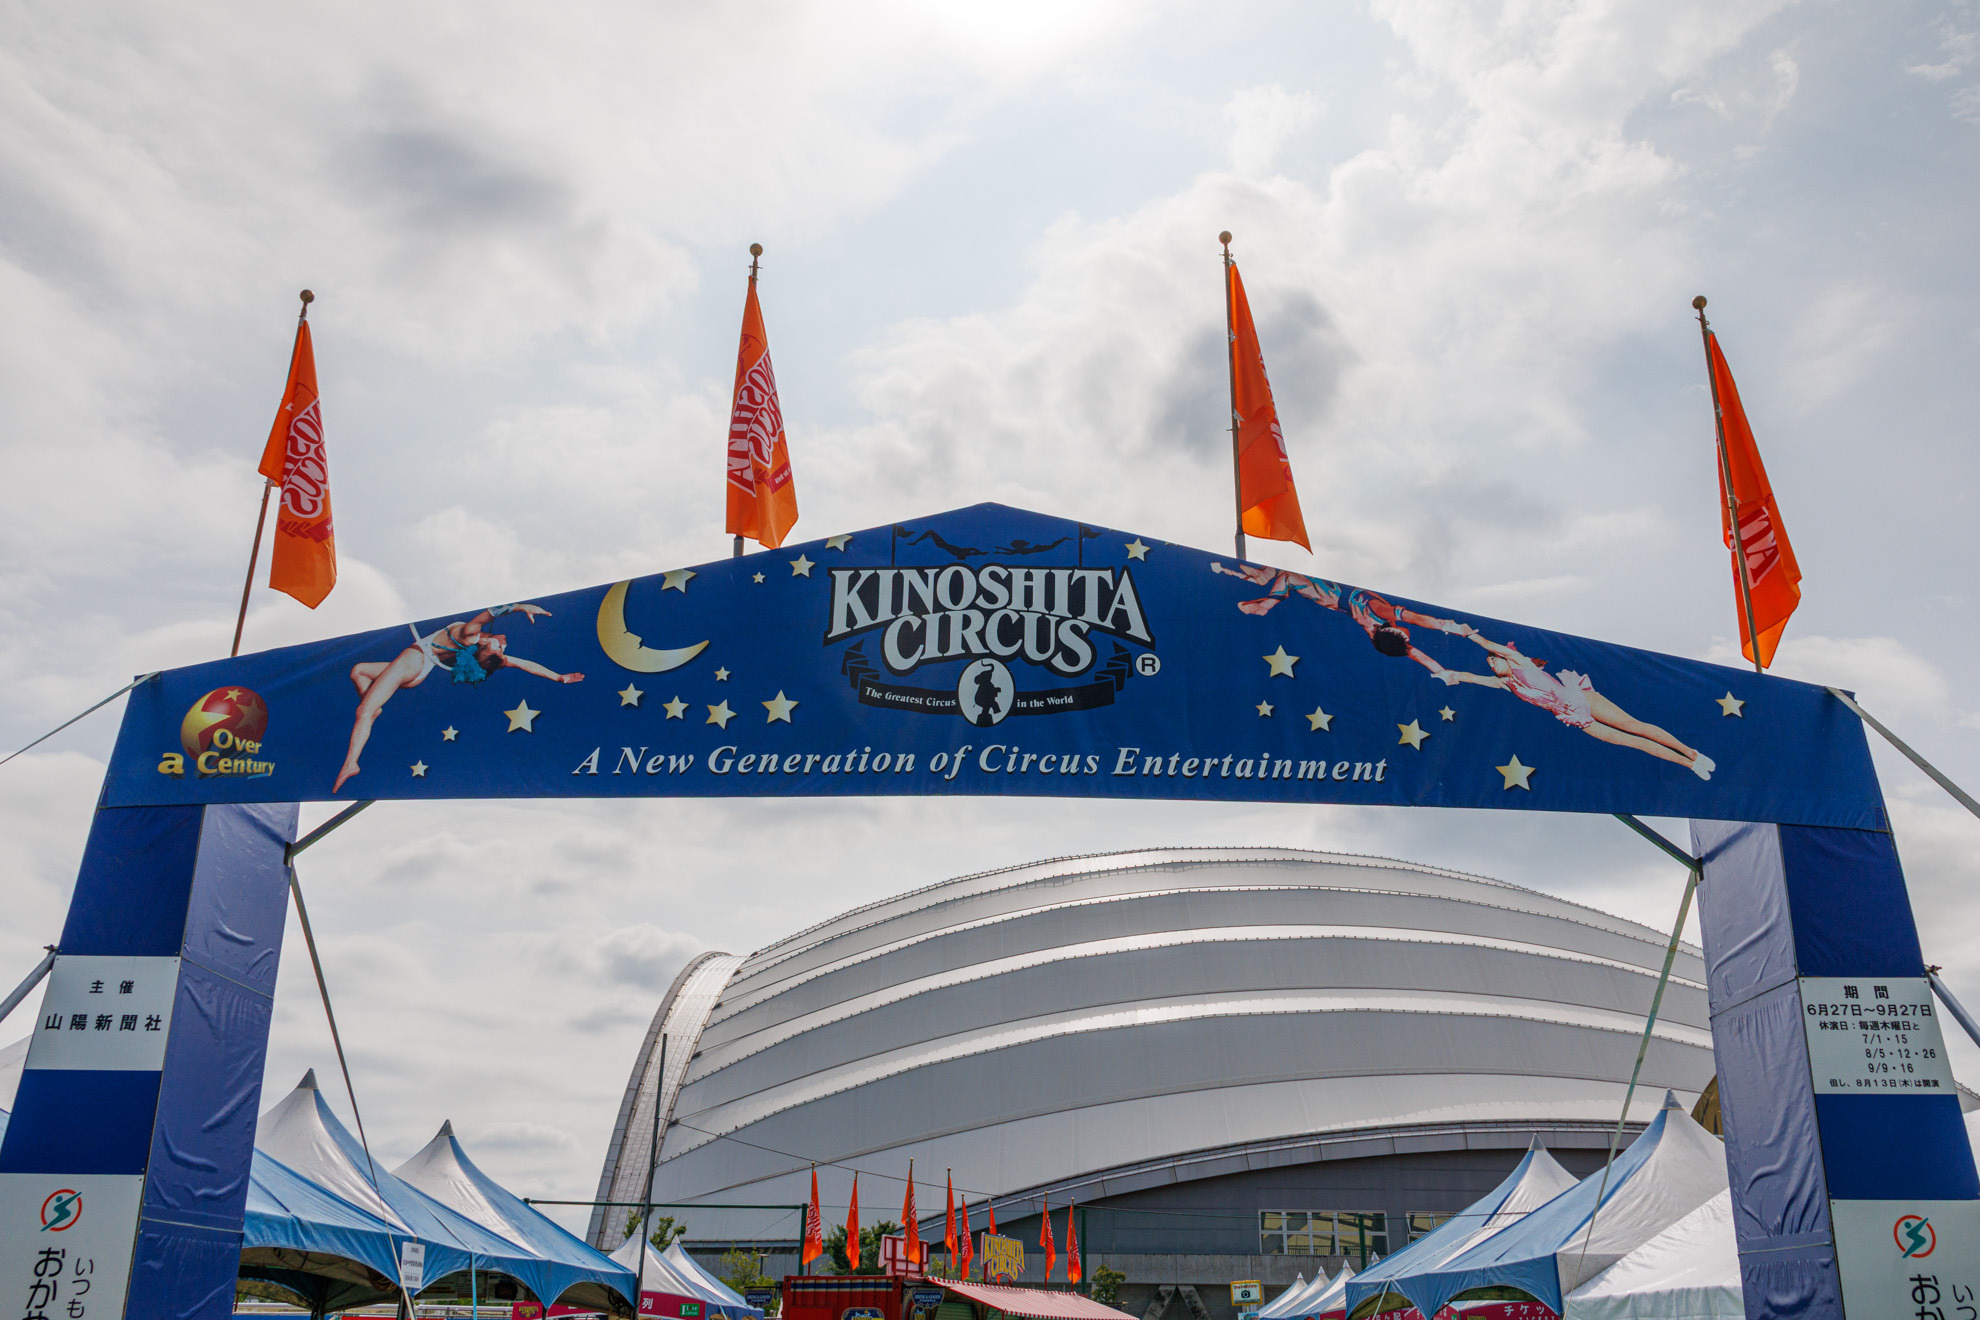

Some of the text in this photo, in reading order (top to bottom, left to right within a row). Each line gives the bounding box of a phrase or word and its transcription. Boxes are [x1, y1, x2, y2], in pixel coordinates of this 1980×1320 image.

[827, 565, 1152, 641] KINOSHITA
[883, 609, 1091, 673] CIRCUS
[865, 687, 1074, 708] The Greatest Circus in the World
[213, 728, 262, 754] Over
[157, 751, 275, 776] a Century
[572, 744, 1388, 783] A New Generation of Circus Entertainment
[44, 1013, 163, 1032] 山陽新聞社
[984, 1235, 1025, 1270] KINOSHITA
[991, 1254, 1019, 1281] CIRCUS
[66, 1257, 94, 1319] いつも
